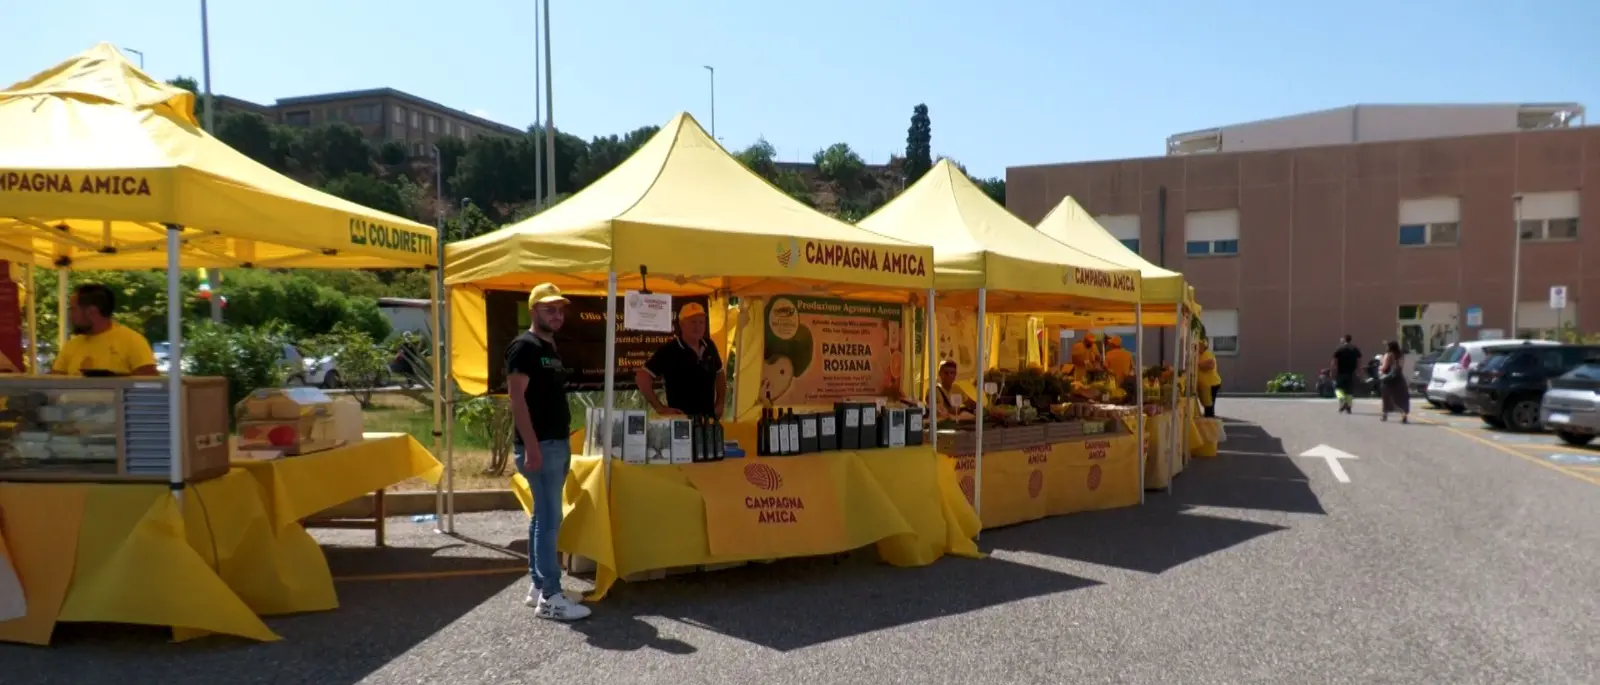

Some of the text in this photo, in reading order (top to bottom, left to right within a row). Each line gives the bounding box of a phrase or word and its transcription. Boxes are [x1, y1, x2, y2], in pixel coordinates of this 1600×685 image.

[79, 175, 151, 196] AMICA
[368, 223, 432, 256] COLDIRETTI
[805, 241, 926, 277] CAMPAGNA AMICA
[1075, 267, 1135, 292] CAMPAGNA AMICA
[797, 299, 842, 313] Produzione
[822, 342, 872, 356] PANZERA
[823, 359, 871, 371] ROSSANA
[955, 459, 976, 471] AMIC
[745, 496, 804, 510] CAMPAGNA
[758, 510, 797, 524] AMICA
